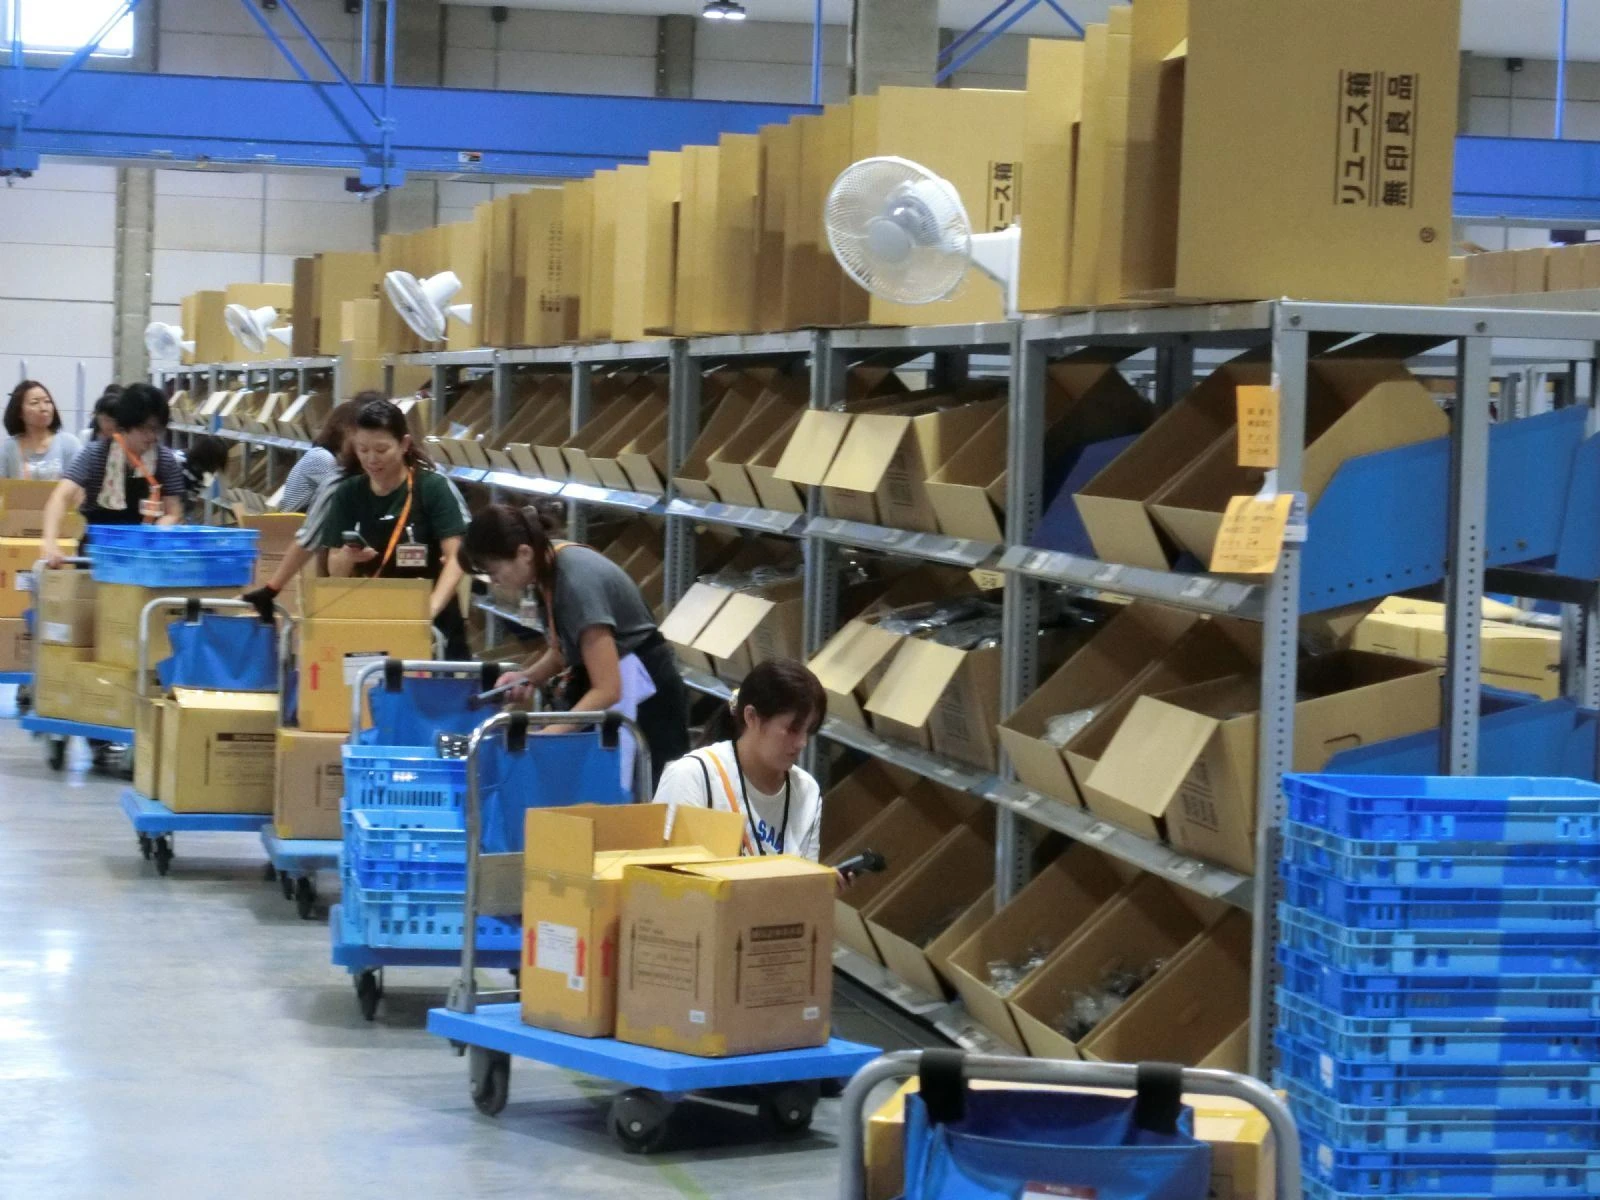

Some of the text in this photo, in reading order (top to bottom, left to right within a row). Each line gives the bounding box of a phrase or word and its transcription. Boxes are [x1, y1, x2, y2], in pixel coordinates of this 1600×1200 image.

[1341, 71, 1372, 205] リユース箱
[1382, 74, 1413, 206] 無印良品
